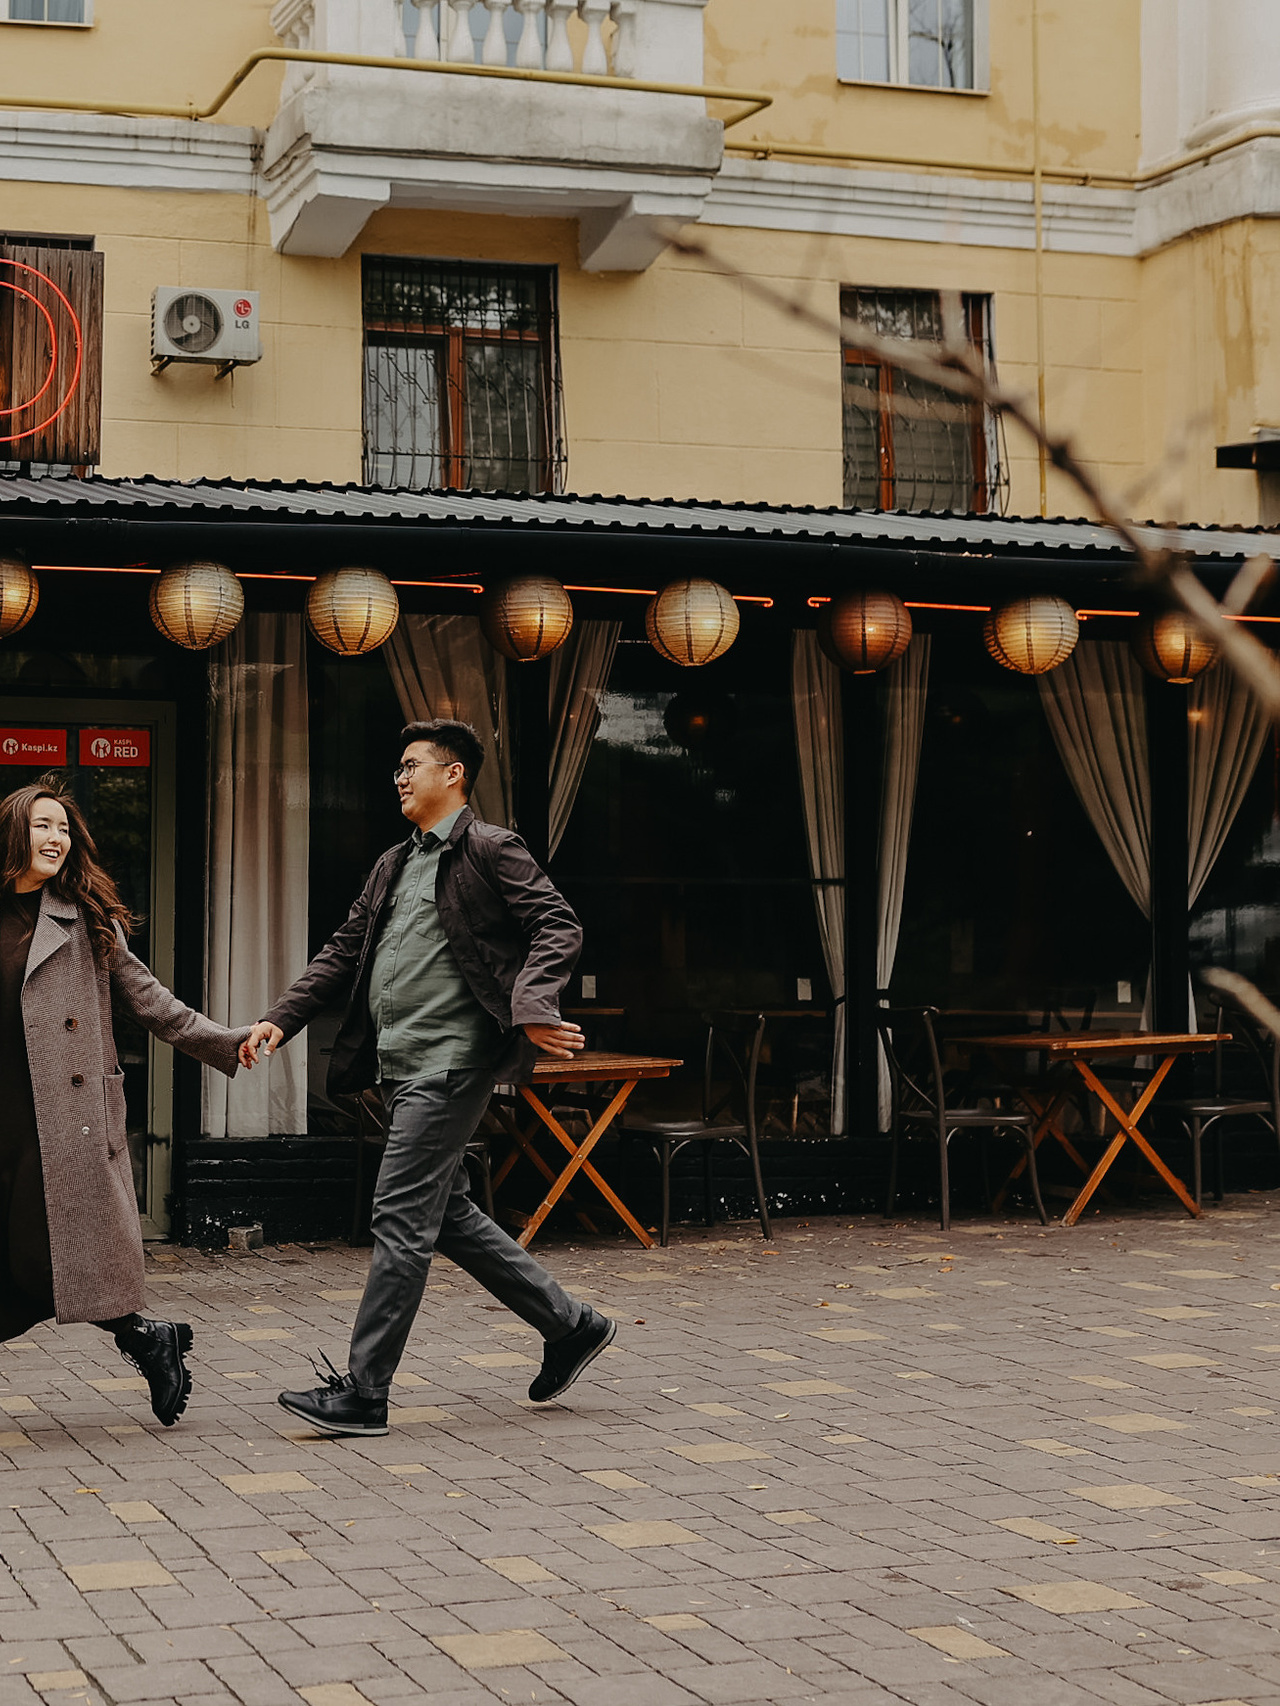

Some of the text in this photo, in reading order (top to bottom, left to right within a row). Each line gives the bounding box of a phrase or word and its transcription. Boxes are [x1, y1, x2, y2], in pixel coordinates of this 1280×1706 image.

[235, 320, 250, 329] LG
[21, 742, 58, 753] Kaspi.kz
[114, 747, 138, 758] RED
